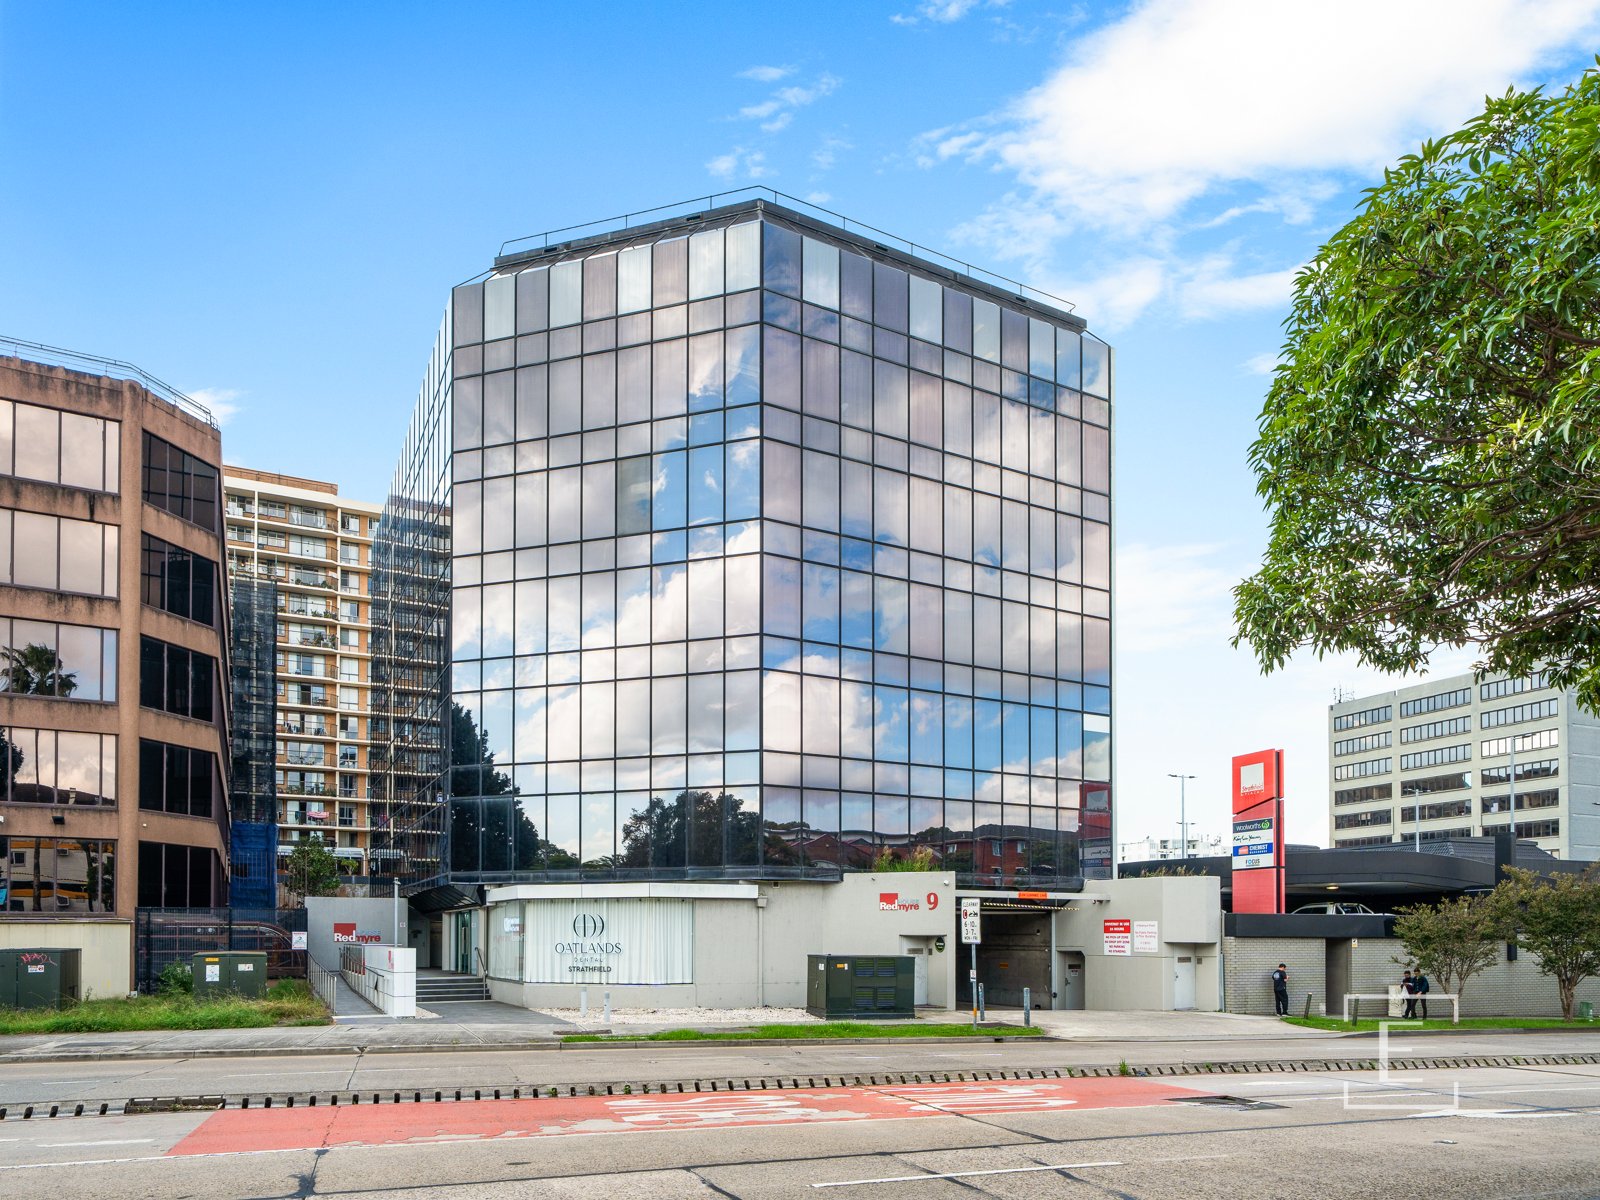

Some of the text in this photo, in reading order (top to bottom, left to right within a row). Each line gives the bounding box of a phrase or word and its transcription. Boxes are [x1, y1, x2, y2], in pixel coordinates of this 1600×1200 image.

[880, 899, 920, 913] Redmyre
[926, 892, 939, 911] 9
[334, 930, 381, 944] Redmyre
[555, 942, 622, 954] OATLANDS
[568, 965, 612, 973] STRATHFIELD
